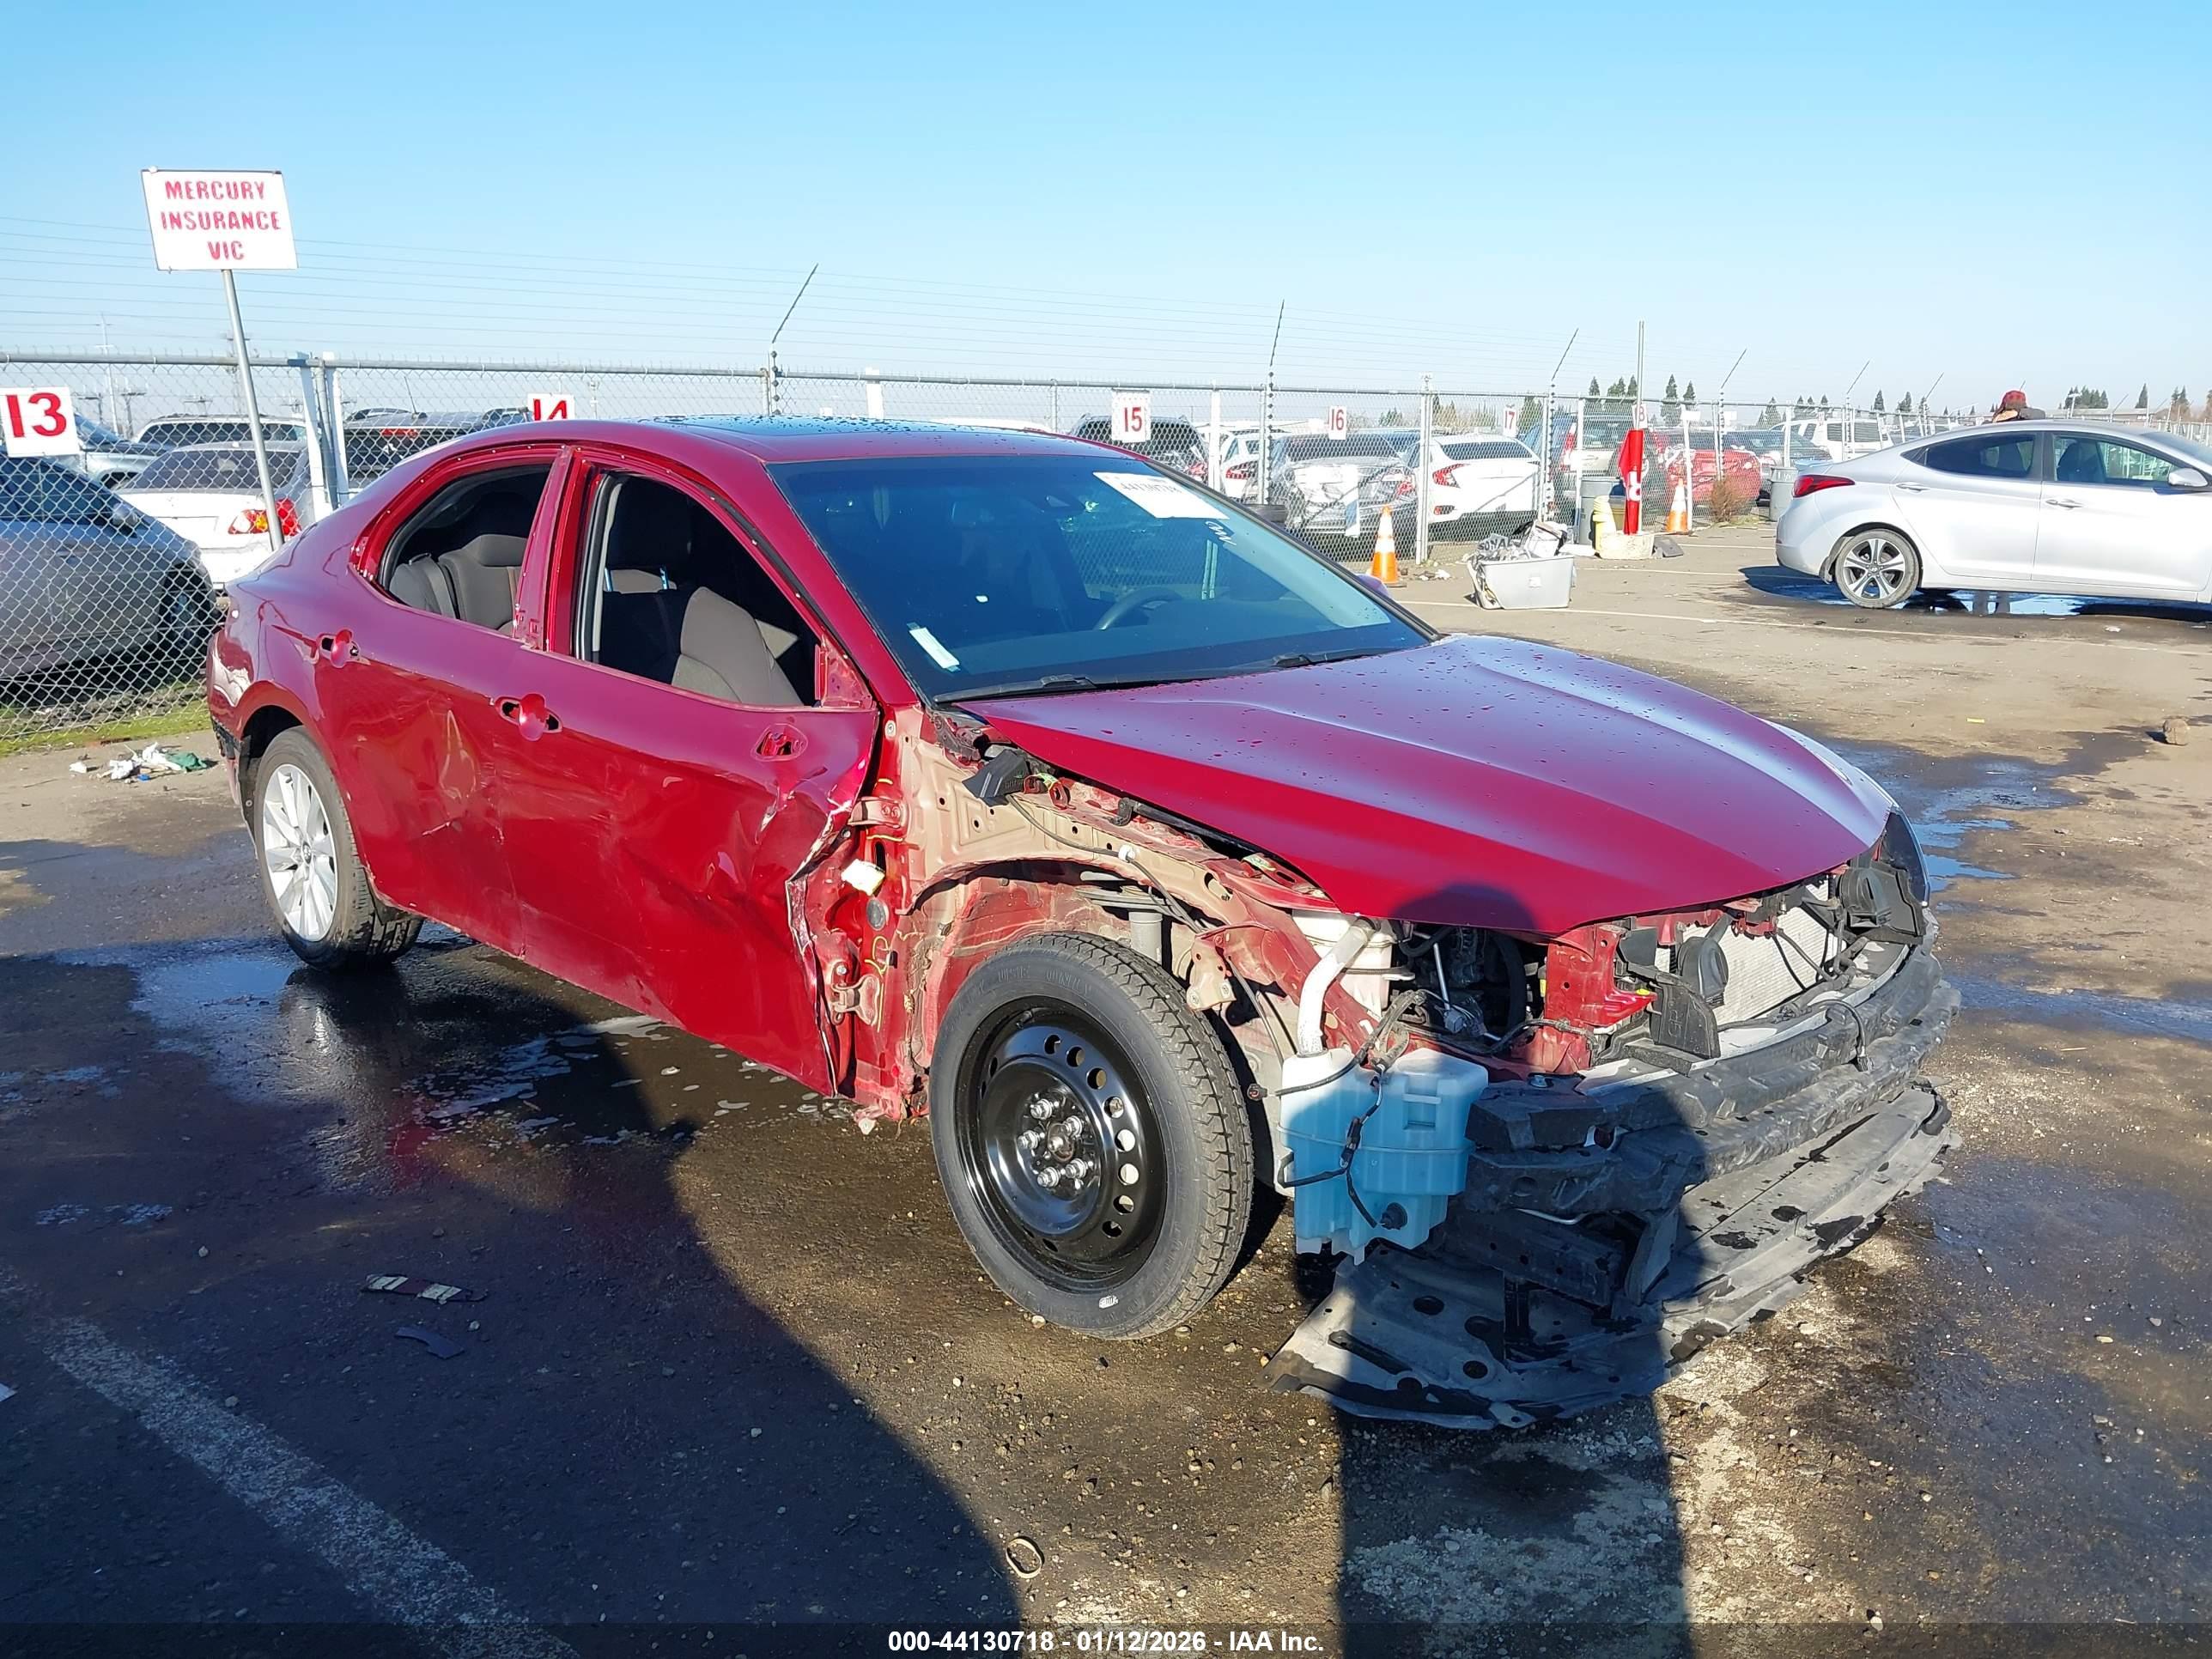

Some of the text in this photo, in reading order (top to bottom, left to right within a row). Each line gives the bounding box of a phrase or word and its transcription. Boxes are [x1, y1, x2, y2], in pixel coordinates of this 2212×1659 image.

[165, 179, 265, 200] MERCURY
[161, 210, 281, 231] INSURANCE
[208, 240, 245, 260] VIC
[6, 392, 67, 438] 13
[1124, 406, 1143, 433] 15
[1331, 408, 1345, 431] 16
[1504, 410, 1516, 429] 17
